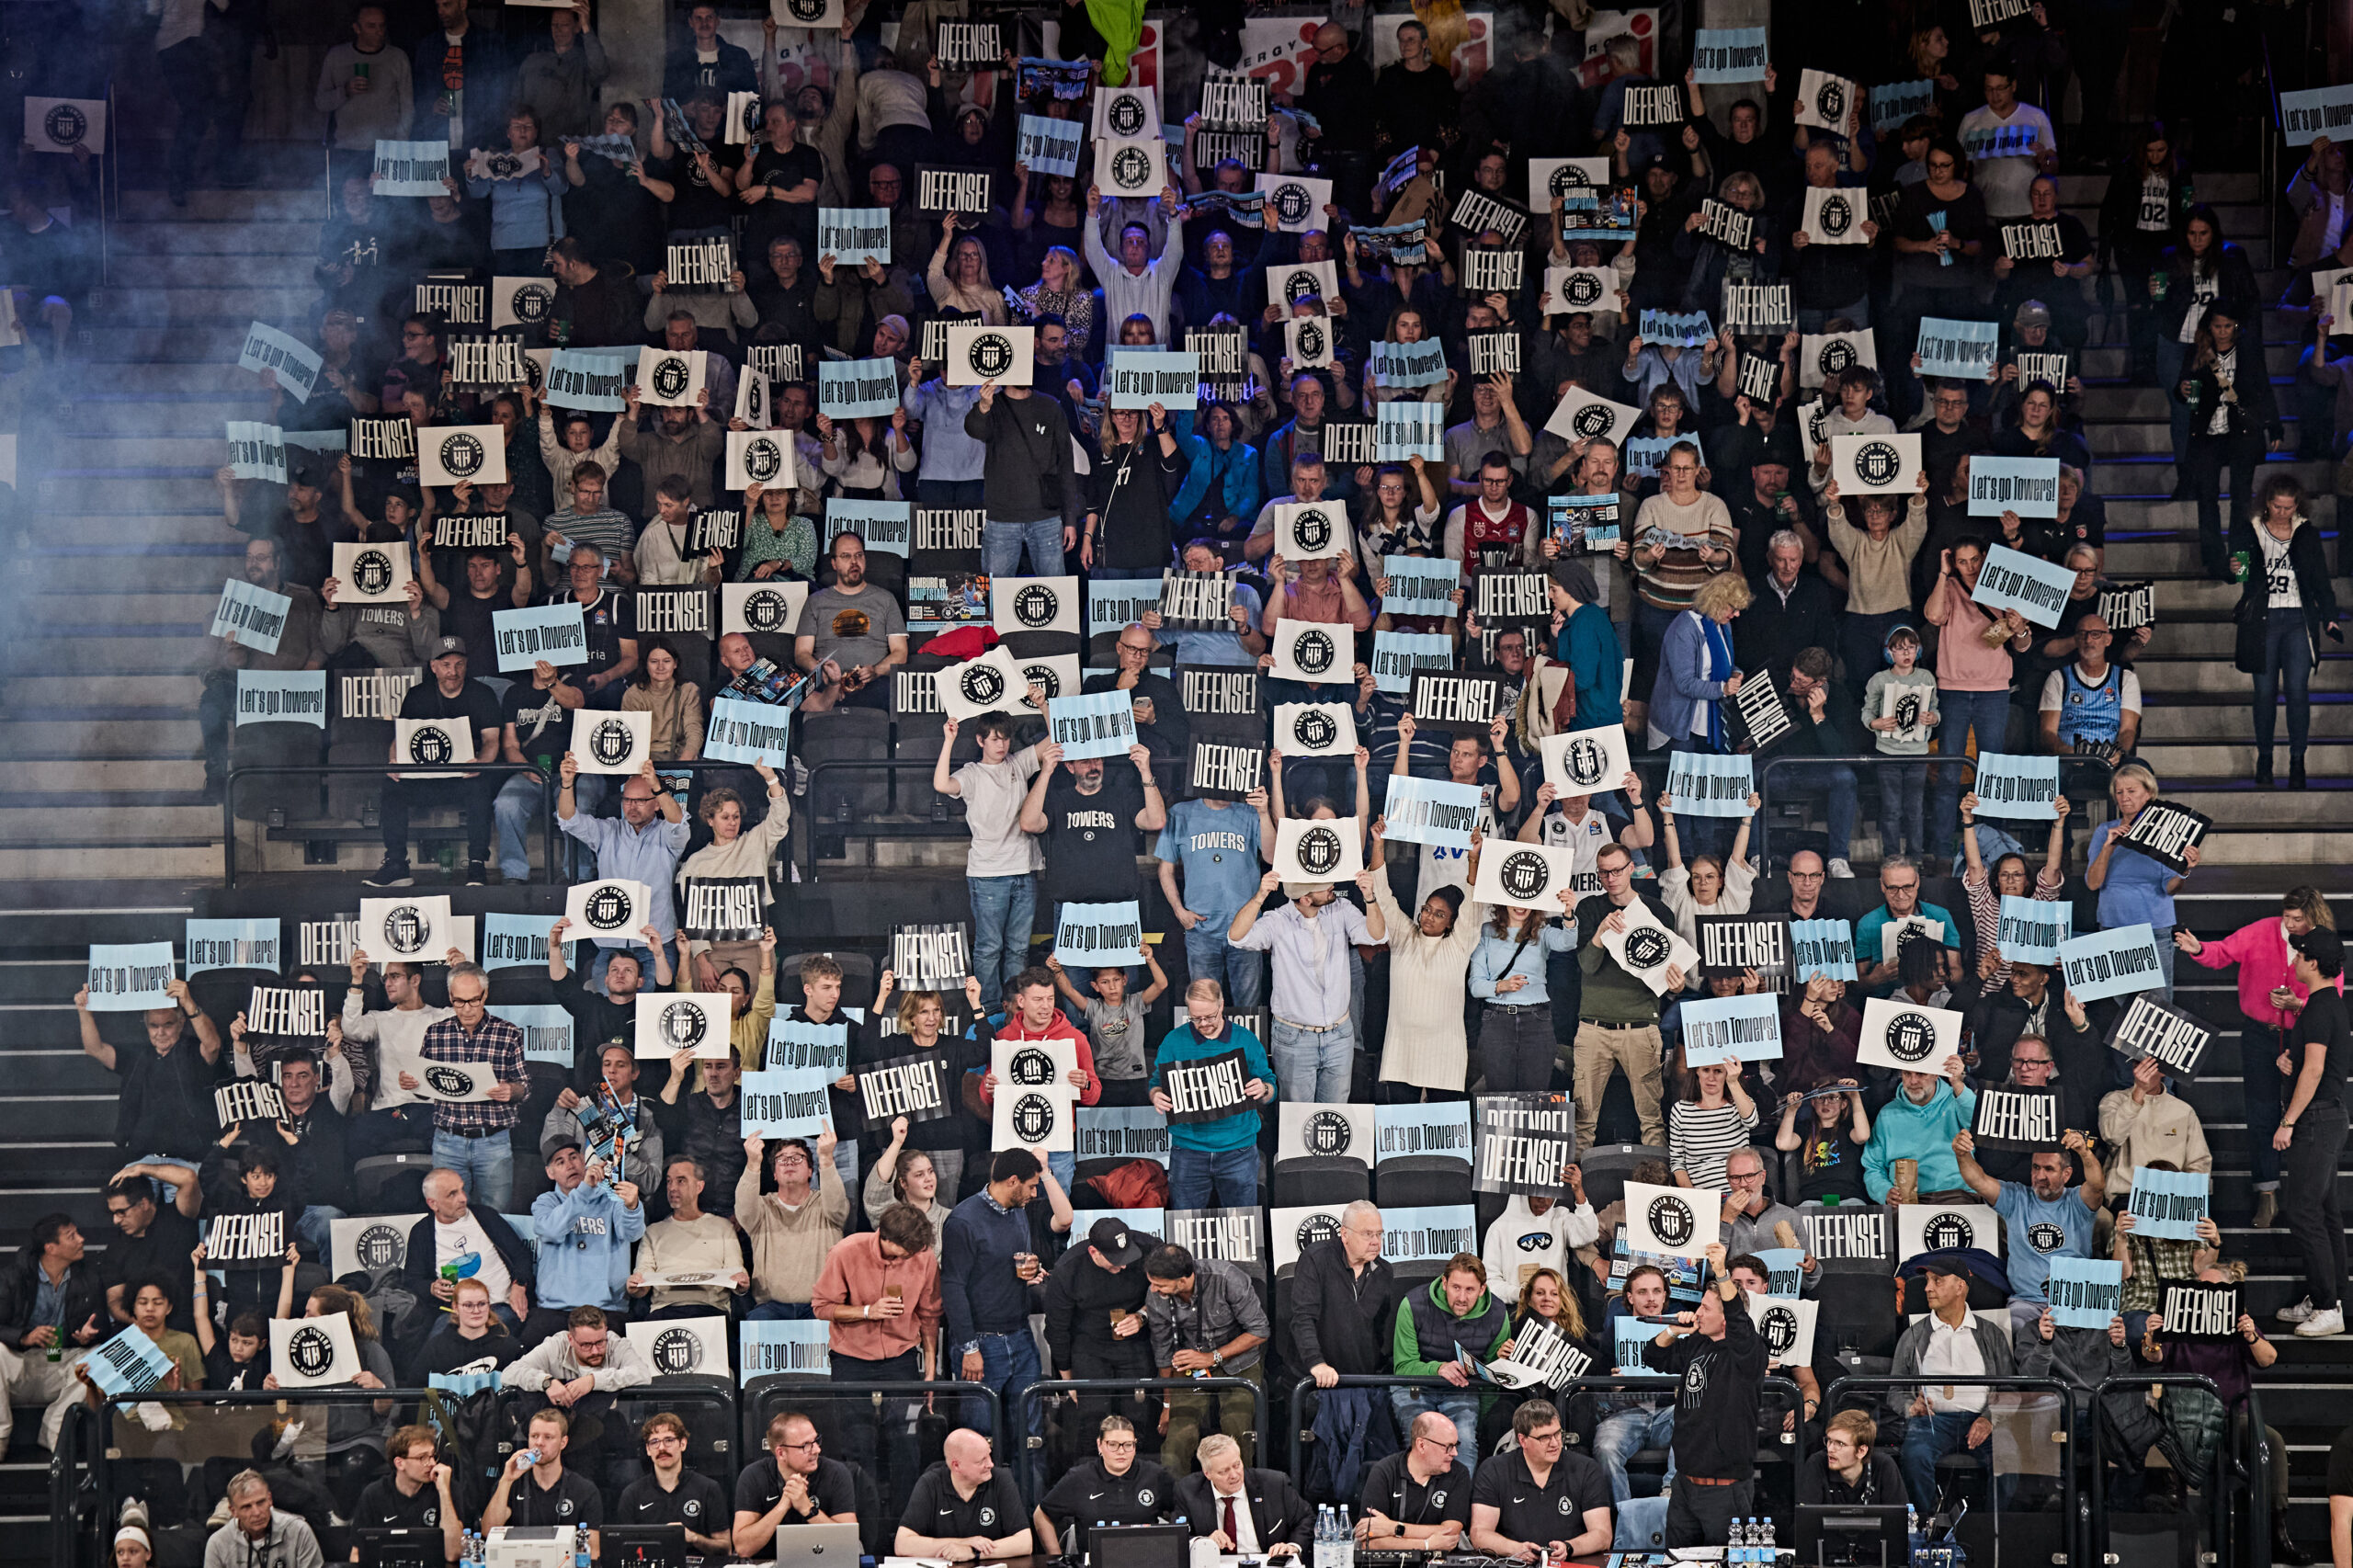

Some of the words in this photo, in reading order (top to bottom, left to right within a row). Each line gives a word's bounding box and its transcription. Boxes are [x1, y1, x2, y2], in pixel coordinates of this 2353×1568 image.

[938, 24, 1001, 64] DEFENSE!
[1695, 48, 1714, 69] Let's
[1717, 49, 1726, 71] go
[1729, 44, 1765, 67] Towers!
[1201, 82, 1266, 122] DEFENSE!
[1623, 85, 1683, 124] DEFENSE!
[377, 158, 398, 181] Let's
[399, 160, 411, 182] go
[412, 158, 447, 181] Towers!
[920, 171, 989, 212] DEFENSE!
[821, 226, 840, 249] Let's
[841, 229, 851, 251] go
[854, 226, 888, 249] Towers!
[2002, 223, 2063, 259] DEFENSE!
[668, 244, 731, 283] DEFENSE!
[1465, 250, 1523, 290] DEFENSE!
[1726, 285, 1790, 325] DEFENSE!
[971, 336, 990, 355] VEOLIA
[992, 336, 1011, 355] TOWERS
[983, 352, 999, 368] HH
[245, 335, 268, 364] Let's
[269, 349, 282, 367] go
[283, 352, 317, 391] Towers!
[453, 343, 521, 382] DEFENSE!
[1374, 356, 1395, 375] Let's
[1397, 358, 1406, 376] go
[1406, 351, 1443, 375] Towers!
[549, 367, 571, 392] Let's
[572, 373, 584, 395] go
[585, 372, 621, 397] Towers!
[822, 380, 843, 403] Let's
[846, 381, 856, 404] go
[857, 375, 896, 403] Towers!
[1116, 370, 1139, 393] Let's
[1142, 374, 1153, 396] go
[1155, 370, 1195, 393] Towers!
[351, 417, 415, 459] DEFENSE!
[1857, 445, 1875, 464] VEOLIA
[1877, 444, 1897, 463] TOWERS
[1869, 460, 1886, 477] HH
[1972, 475, 1996, 500] Let's
[1999, 478, 2010, 502] go
[2014, 476, 2055, 501] Towers!
[435, 517, 506, 546] DEFENSE!
[909, 577, 938, 588] HAMBURG
[909, 588, 948, 600] HAUPTSTADT
[1479, 574, 1552, 616] DEFENSE!
[1981, 562, 2006, 592] Let's
[2006, 571, 2024, 597] go
[2021, 576, 2067, 612] Towers!
[637, 591, 708, 631] DEFENSE!
[1165, 577, 1229, 621] DEFENSE!
[361, 609, 404, 626] TOWERS
[443, 638, 456, 649] HH
[498, 629, 524, 654] Let's
[529, 629, 539, 653] go
[540, 622, 583, 651] Towers!
[241, 689, 265, 713] Let's
[267, 691, 279, 715] go
[281, 689, 323, 712] Towers!
[1183, 671, 1256, 713] DEFENSE!
[1415, 676, 1496, 722] DEFENSE!
[1735, 670, 1790, 746] DEFENSE!
[1053, 718, 1075, 744] Let's
[1078, 719, 1090, 744] go
[1091, 710, 1132, 742] Towers!
[1193, 743, 1262, 792] DEFENSE!
[1669, 771, 1694, 796] Let's
[1697, 776, 1708, 801] go
[1711, 776, 1749, 801] Towers!
[1979, 773, 2002, 799] Let's
[2005, 778, 2015, 802] go
[2018, 776, 2056, 801] Towers!
[1066, 812, 1115, 829] TOWERS
[1190, 831, 1245, 853] TOWERS
[1504, 852, 1525, 872] VEOLIA
[1528, 853, 1547, 877] TOWERS
[1515, 869, 1535, 889] HH
[686, 884, 761, 932] DEFENSE!
[190, 938, 216, 964] Let's
[219, 940, 231, 966] go
[233, 938, 277, 964] Towers!
[1060, 922, 1083, 949] Let's
[1086, 926, 1097, 951] go
[1099, 922, 1141, 949] Towers!
[1703, 922, 1784, 966] DEFENSE!
[894, 932, 965, 978] DEFENSE!
[2065, 960, 2094, 986] Let's
[2095, 955, 2111, 981] go
[2109, 944, 2158, 974] Towers!
[115, 969, 125, 994] go
[248, 986, 324, 1035] DEFENSE!
[1686, 1020, 1714, 1049] Let's
[1716, 1020, 1729, 1048] go
[1730, 1014, 1778, 1043] Towers!
[1888, 1014, 1911, 1034] VEOLIA
[1915, 1015, 1934, 1040] TOWERS
[1901, 1031, 1921, 1051] HH
[2117, 997, 2210, 1074] DEFENSE!
[770, 1039, 794, 1066] Let's
[795, 1044, 807, 1069] go
[810, 1043, 846, 1068] Towers!
[859, 1061, 941, 1119] DEFENSE!
[1167, 1059, 1246, 1112] DEFENSE!
[744, 1093, 767, 1121] Let's
[770, 1095, 782, 1121] go
[783, 1087, 828, 1119] Towers!
[1978, 1090, 2057, 1142] DEFENSE!
[1080, 1128, 1107, 1154] Let's
[1109, 1131, 1122, 1155] go
[1124, 1127, 1169, 1153] Towers!
[1380, 1126, 1405, 1153] Let's
[1409, 1128, 1421, 1153] go
[1423, 1122, 1469, 1151] Towers!
[1481, 1136, 1566, 1187] DEFENSE!
[1649, 1198, 1668, 1218] VEOLIA
[1670, 1198, 1691, 1223] TOWERS
[2131, 1187, 2154, 1218] Let's
[2155, 1195, 2167, 1221] go
[2169, 1194, 2206, 1221] Towers!
[208, 1211, 283, 1259] DEFENSE!
[1662, 1215, 1679, 1236] HH
[1802, 1214, 1886, 1259] DEFENSE!
[1413, 1233, 1425, 1257] go
[2164, 1288, 2235, 1335] DEFENSE!
[302, 1345, 321, 1366] HH
